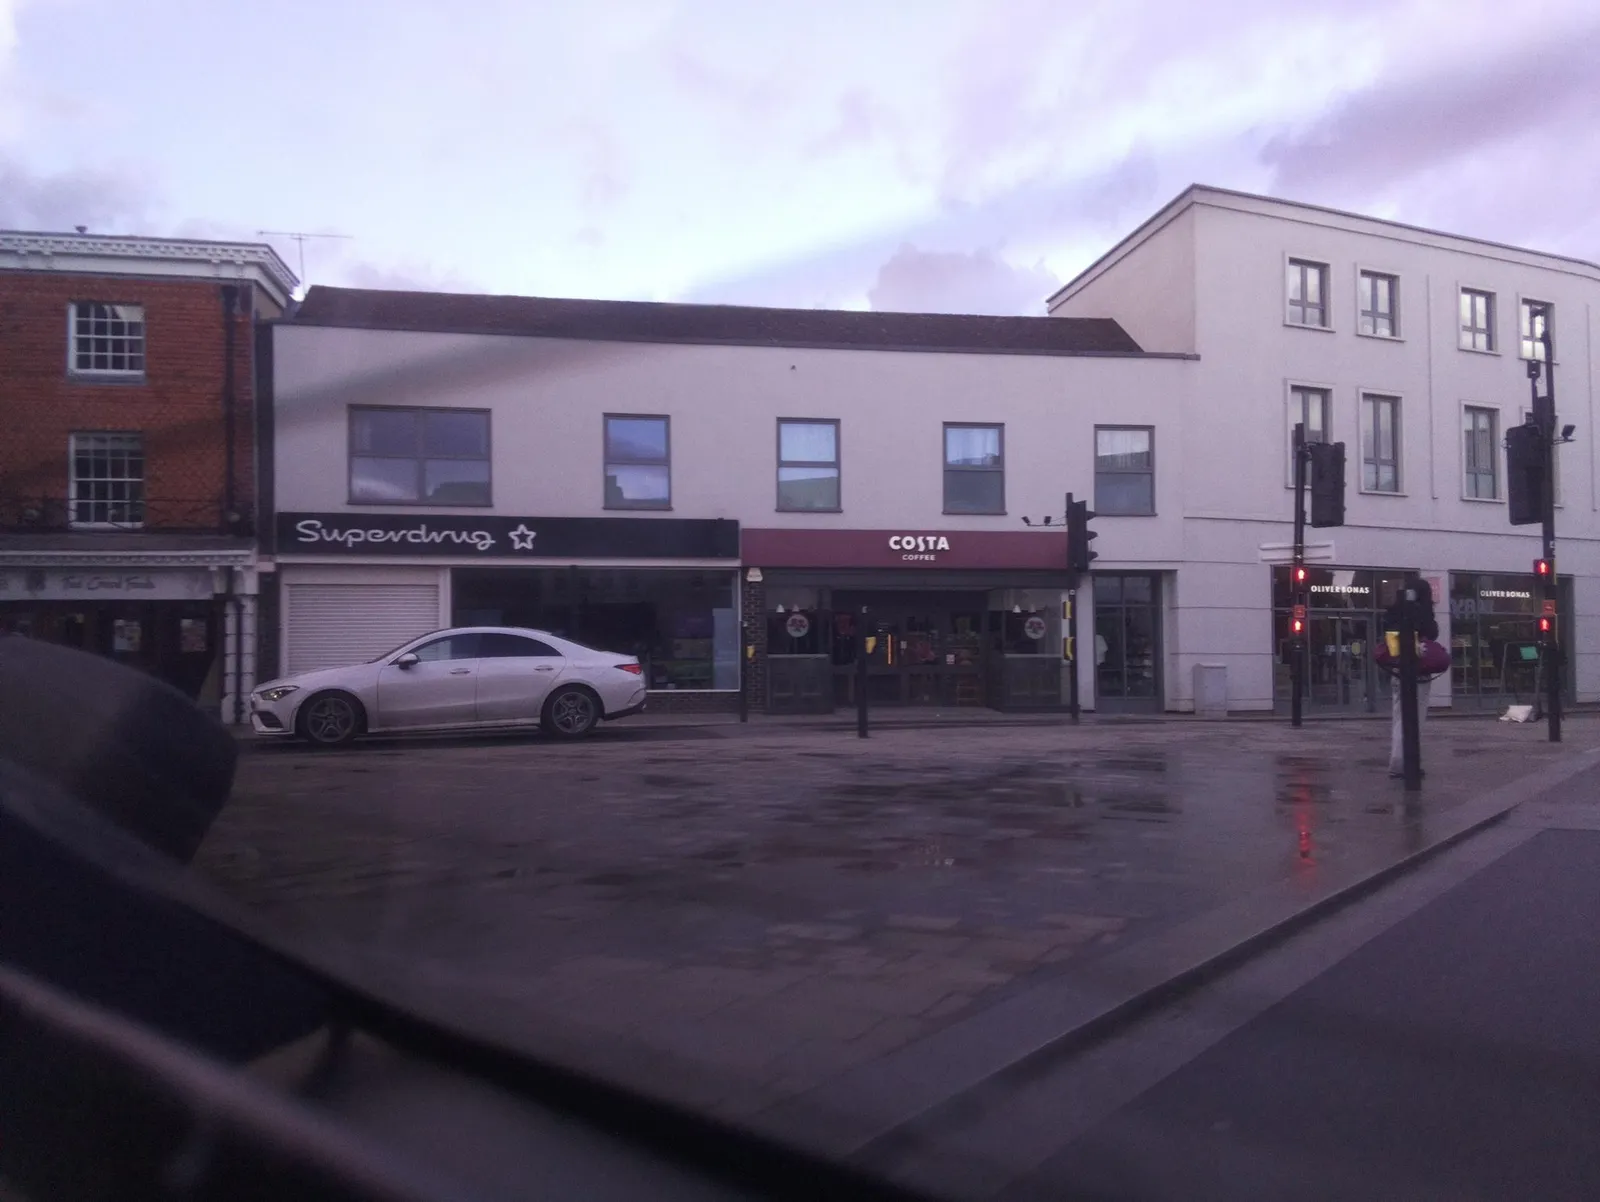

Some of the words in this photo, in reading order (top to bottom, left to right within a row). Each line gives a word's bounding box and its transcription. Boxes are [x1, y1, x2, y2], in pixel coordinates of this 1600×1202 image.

[295, 519, 496, 551] Superdrug
[888, 535, 951, 552] COSTA
[1310, 585, 1341, 593] OLIVER
[1341, 586, 1370, 594] BONAS
[1480, 590, 1506, 598] OLIVER
